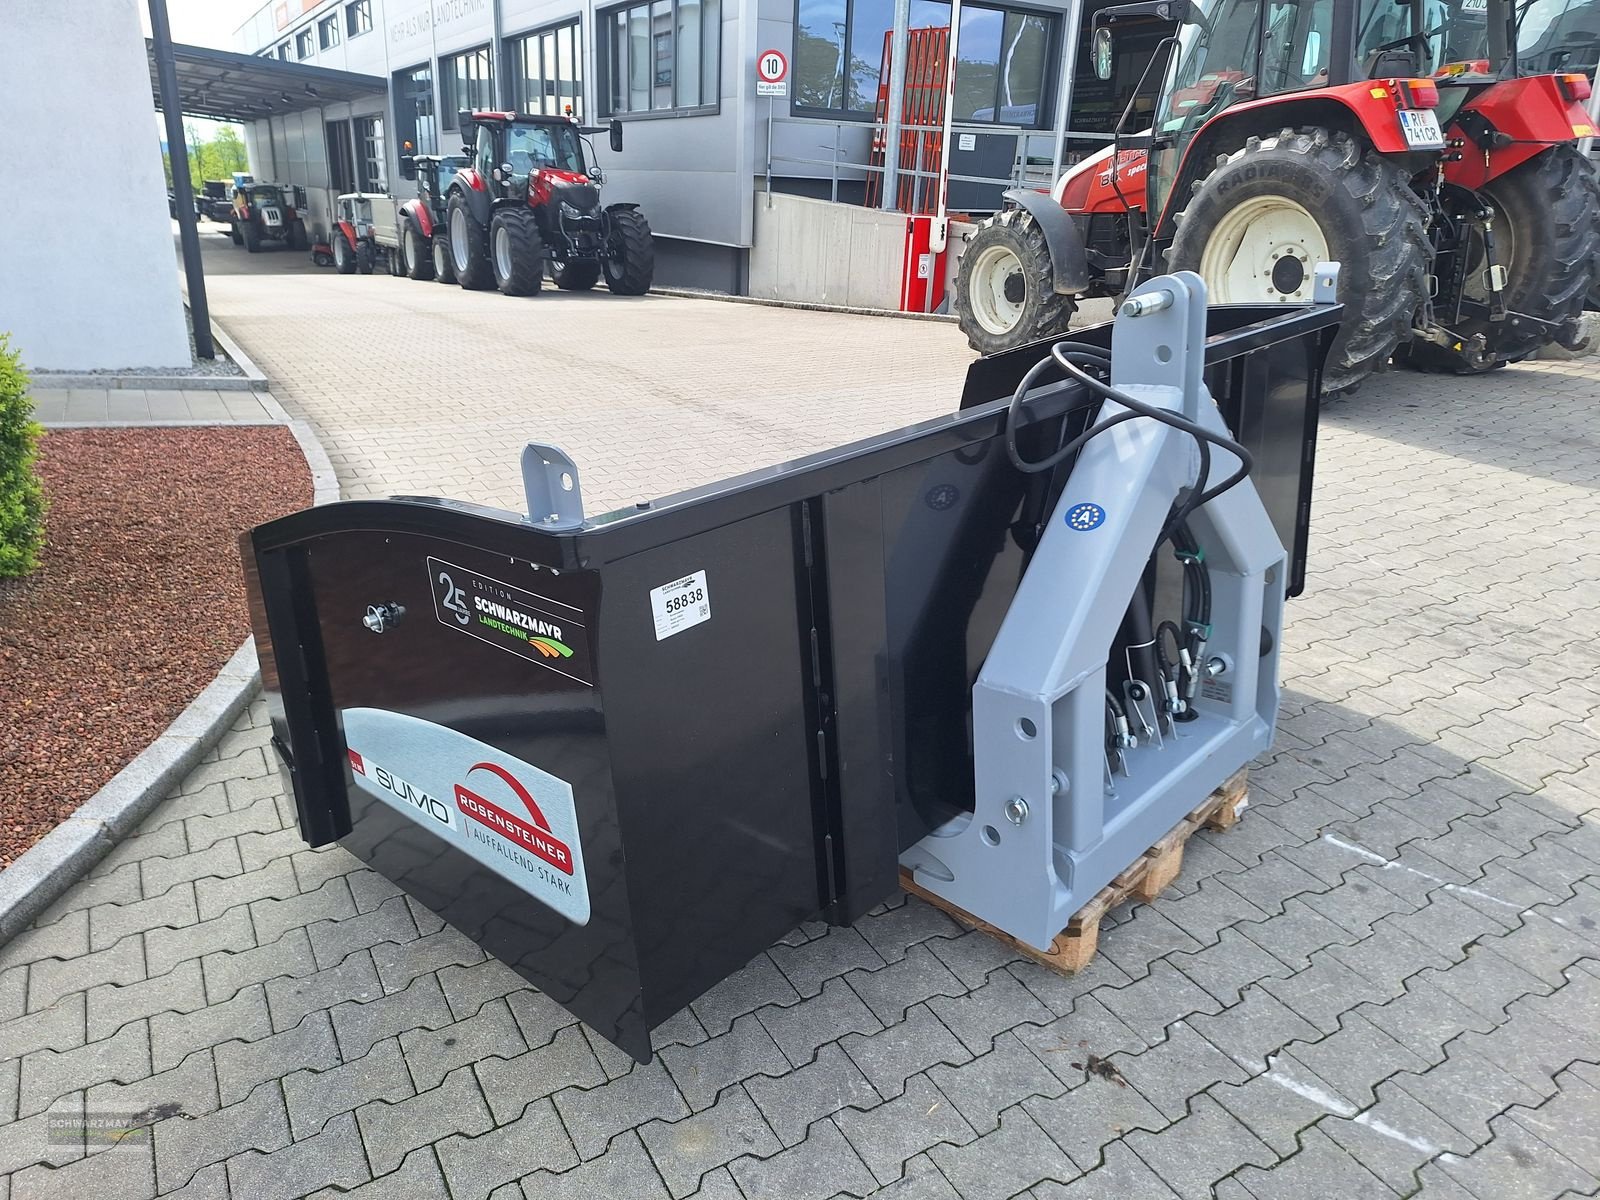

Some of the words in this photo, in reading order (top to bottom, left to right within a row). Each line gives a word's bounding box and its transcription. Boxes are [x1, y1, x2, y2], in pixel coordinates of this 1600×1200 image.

[405, 15, 417, 36] ALS
[417, 10, 430, 32] NUR
[766, 59, 778, 74] 10
[1411, 113, 1422, 127] RI
[1407, 127, 1439, 142] 741CR
[1077, 510, 1090, 523] A
[439, 572, 471, 625] 25
[472, 579, 512, 601] EDITION
[666, 588, 703, 614] 58838
[474, 596, 563, 641] SCHWARZMAYR
[478, 614, 529, 642] LANDTECHNIK
[375, 766, 450, 825] SUMO
[459, 793, 567, 864] ROSENSTEINER
[473, 828, 535, 873] AUFFALLEND
[537, 866, 573, 897] STARK
